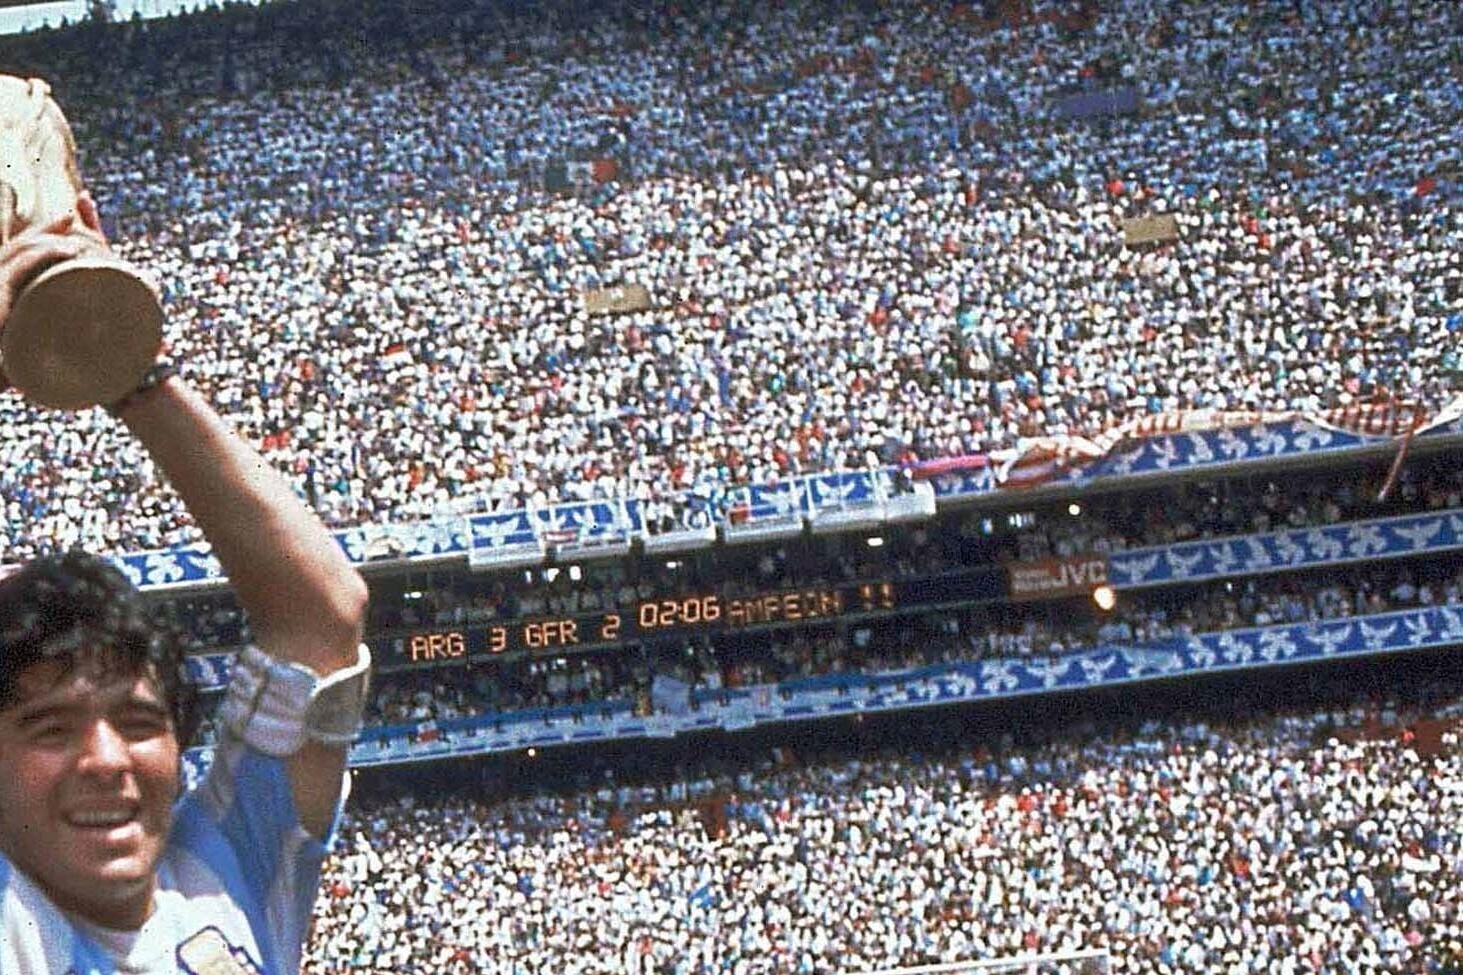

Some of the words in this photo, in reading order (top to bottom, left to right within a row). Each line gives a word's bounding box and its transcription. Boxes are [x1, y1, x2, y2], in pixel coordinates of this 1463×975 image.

[1051, 561, 1107, 588] JVC
[411, 632, 465, 662] ARG
[487, 628, 507, 653] 3
[525, 619, 578, 650] GFR
[602, 615, 621, 640] 2
[639, 596, 721, 629] 02:06
